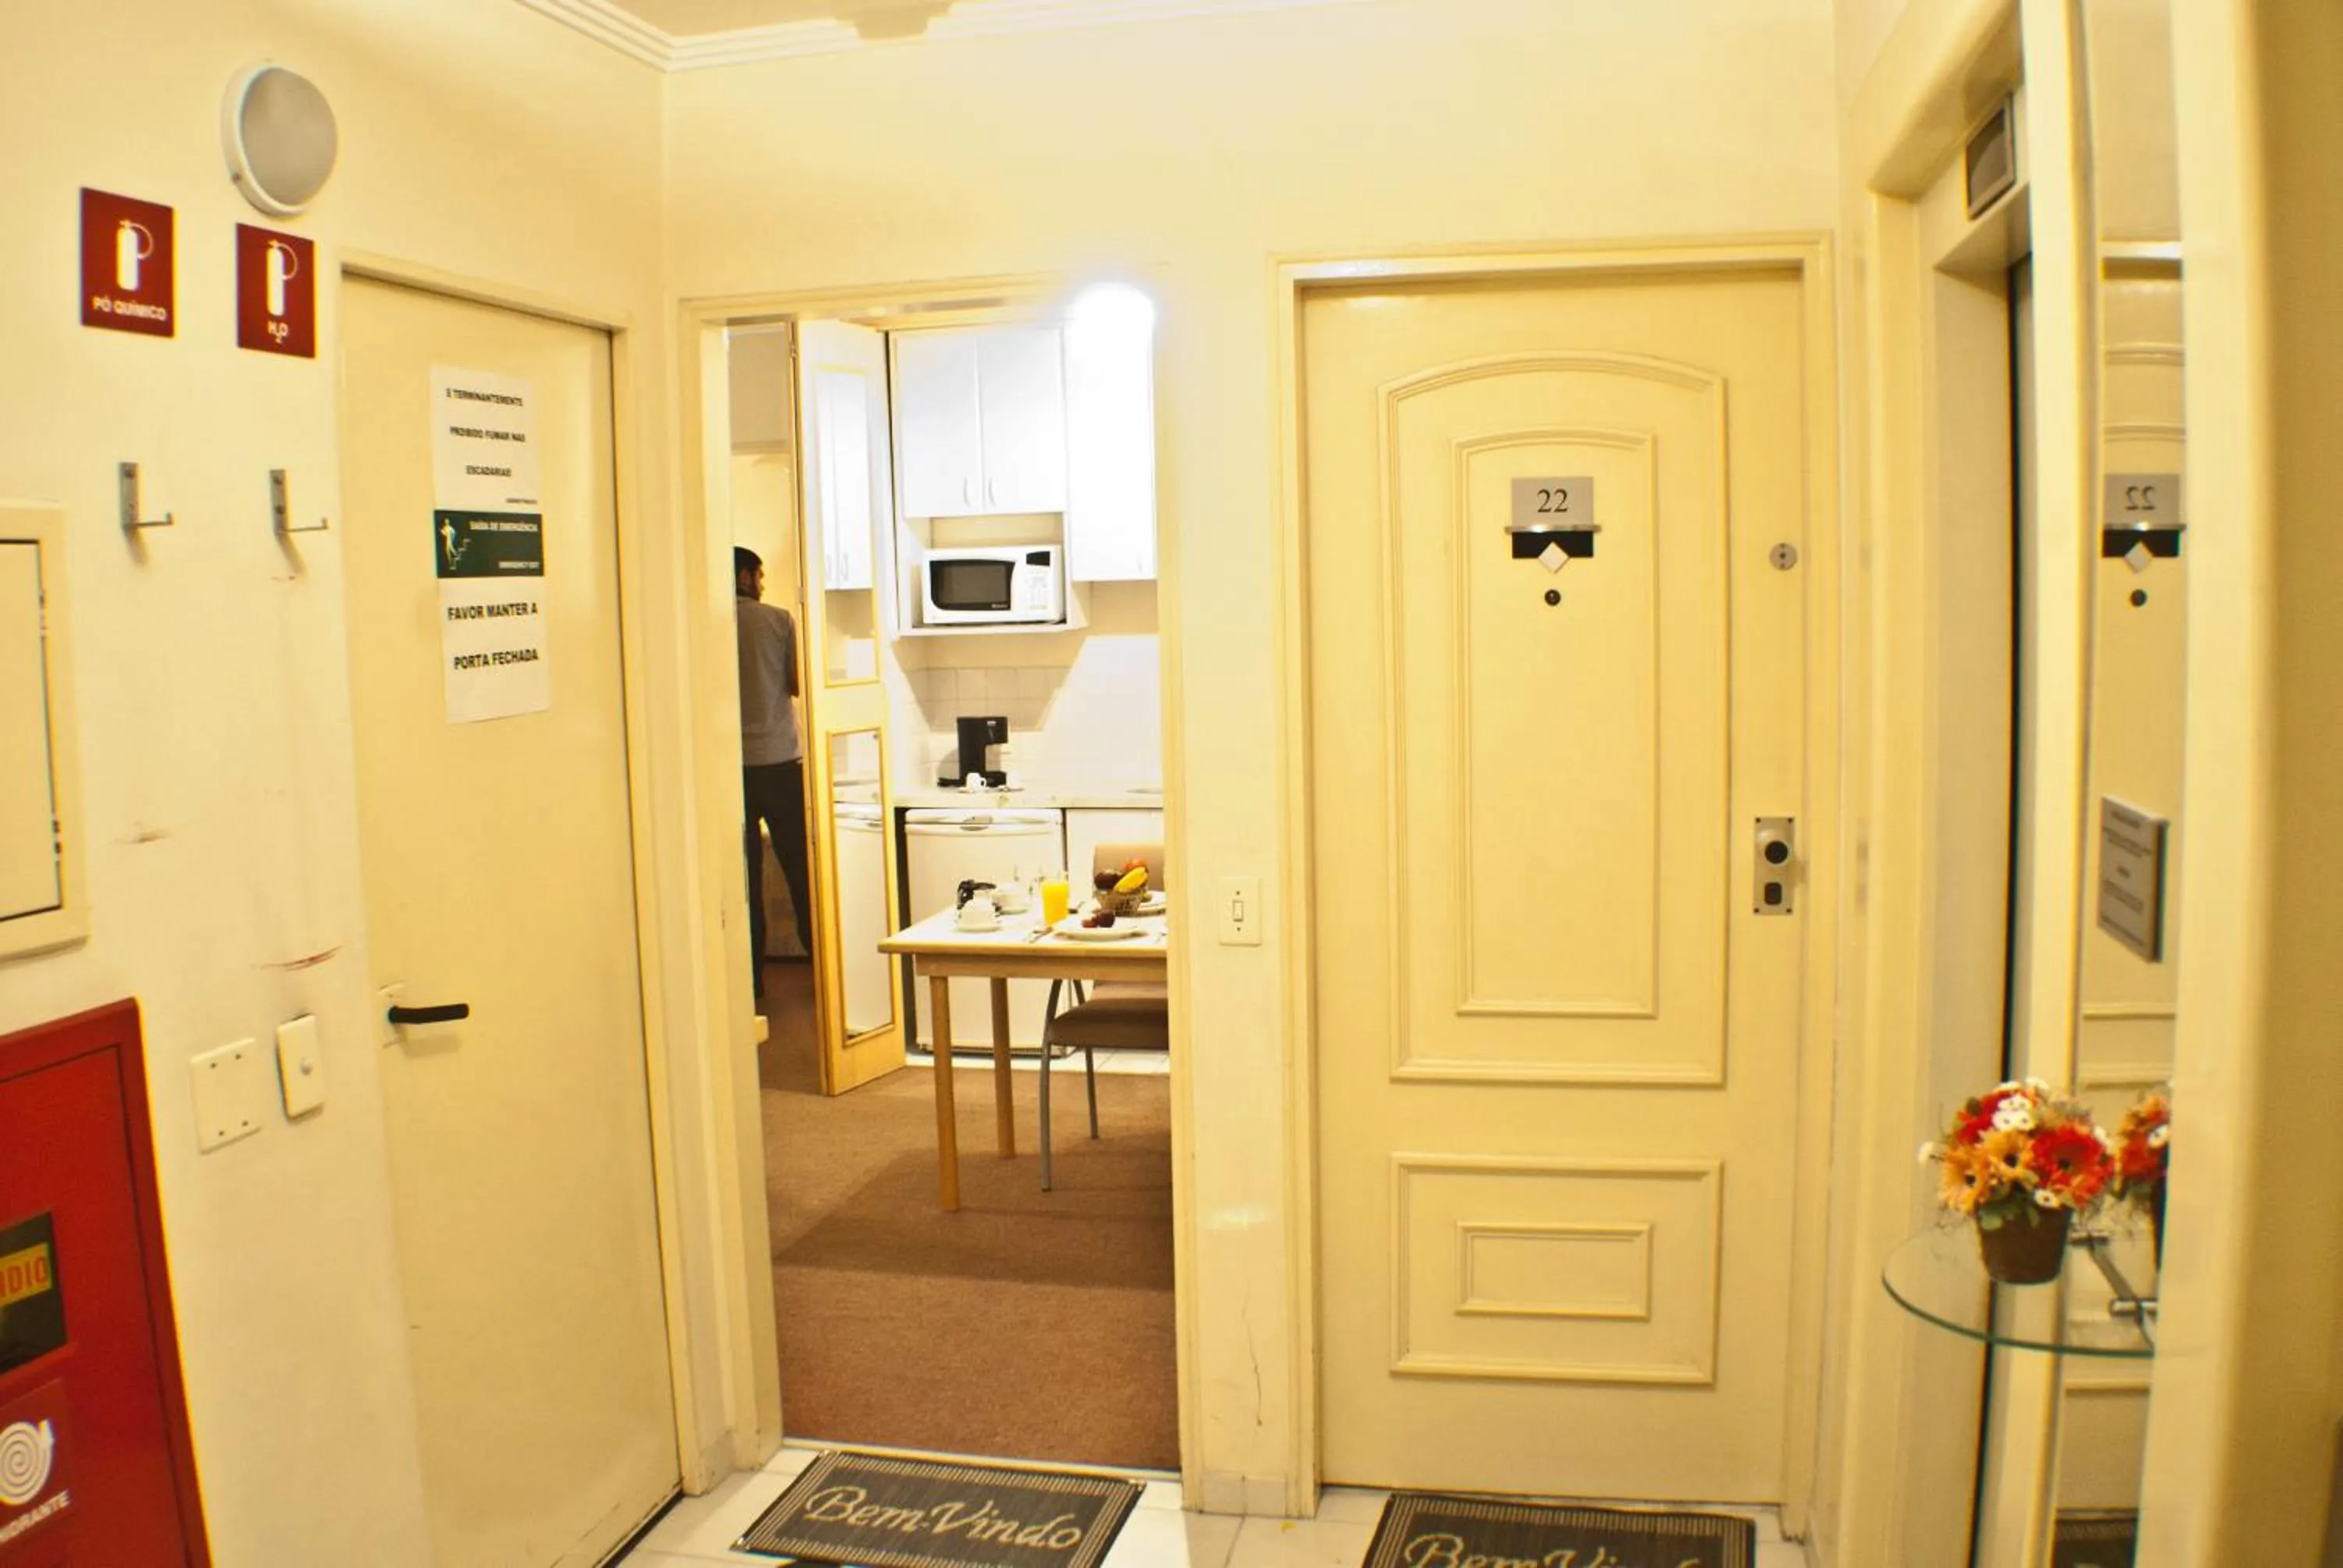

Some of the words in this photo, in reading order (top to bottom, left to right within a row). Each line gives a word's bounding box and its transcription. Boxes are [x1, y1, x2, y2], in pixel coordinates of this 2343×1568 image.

[92, 295, 112, 313] PÓ
[113, 298, 166, 322] QUÍMICO
[1537, 488, 1568, 512] 22
[448, 604, 483, 621] FAVOR
[487, 602, 529, 618] MANTER
[531, 602, 538, 615] A
[454, 654, 490, 669] PORTA
[492, 648, 539, 666] FECHADA
[805, 1485, 1082, 1550] Bem-Vindo
